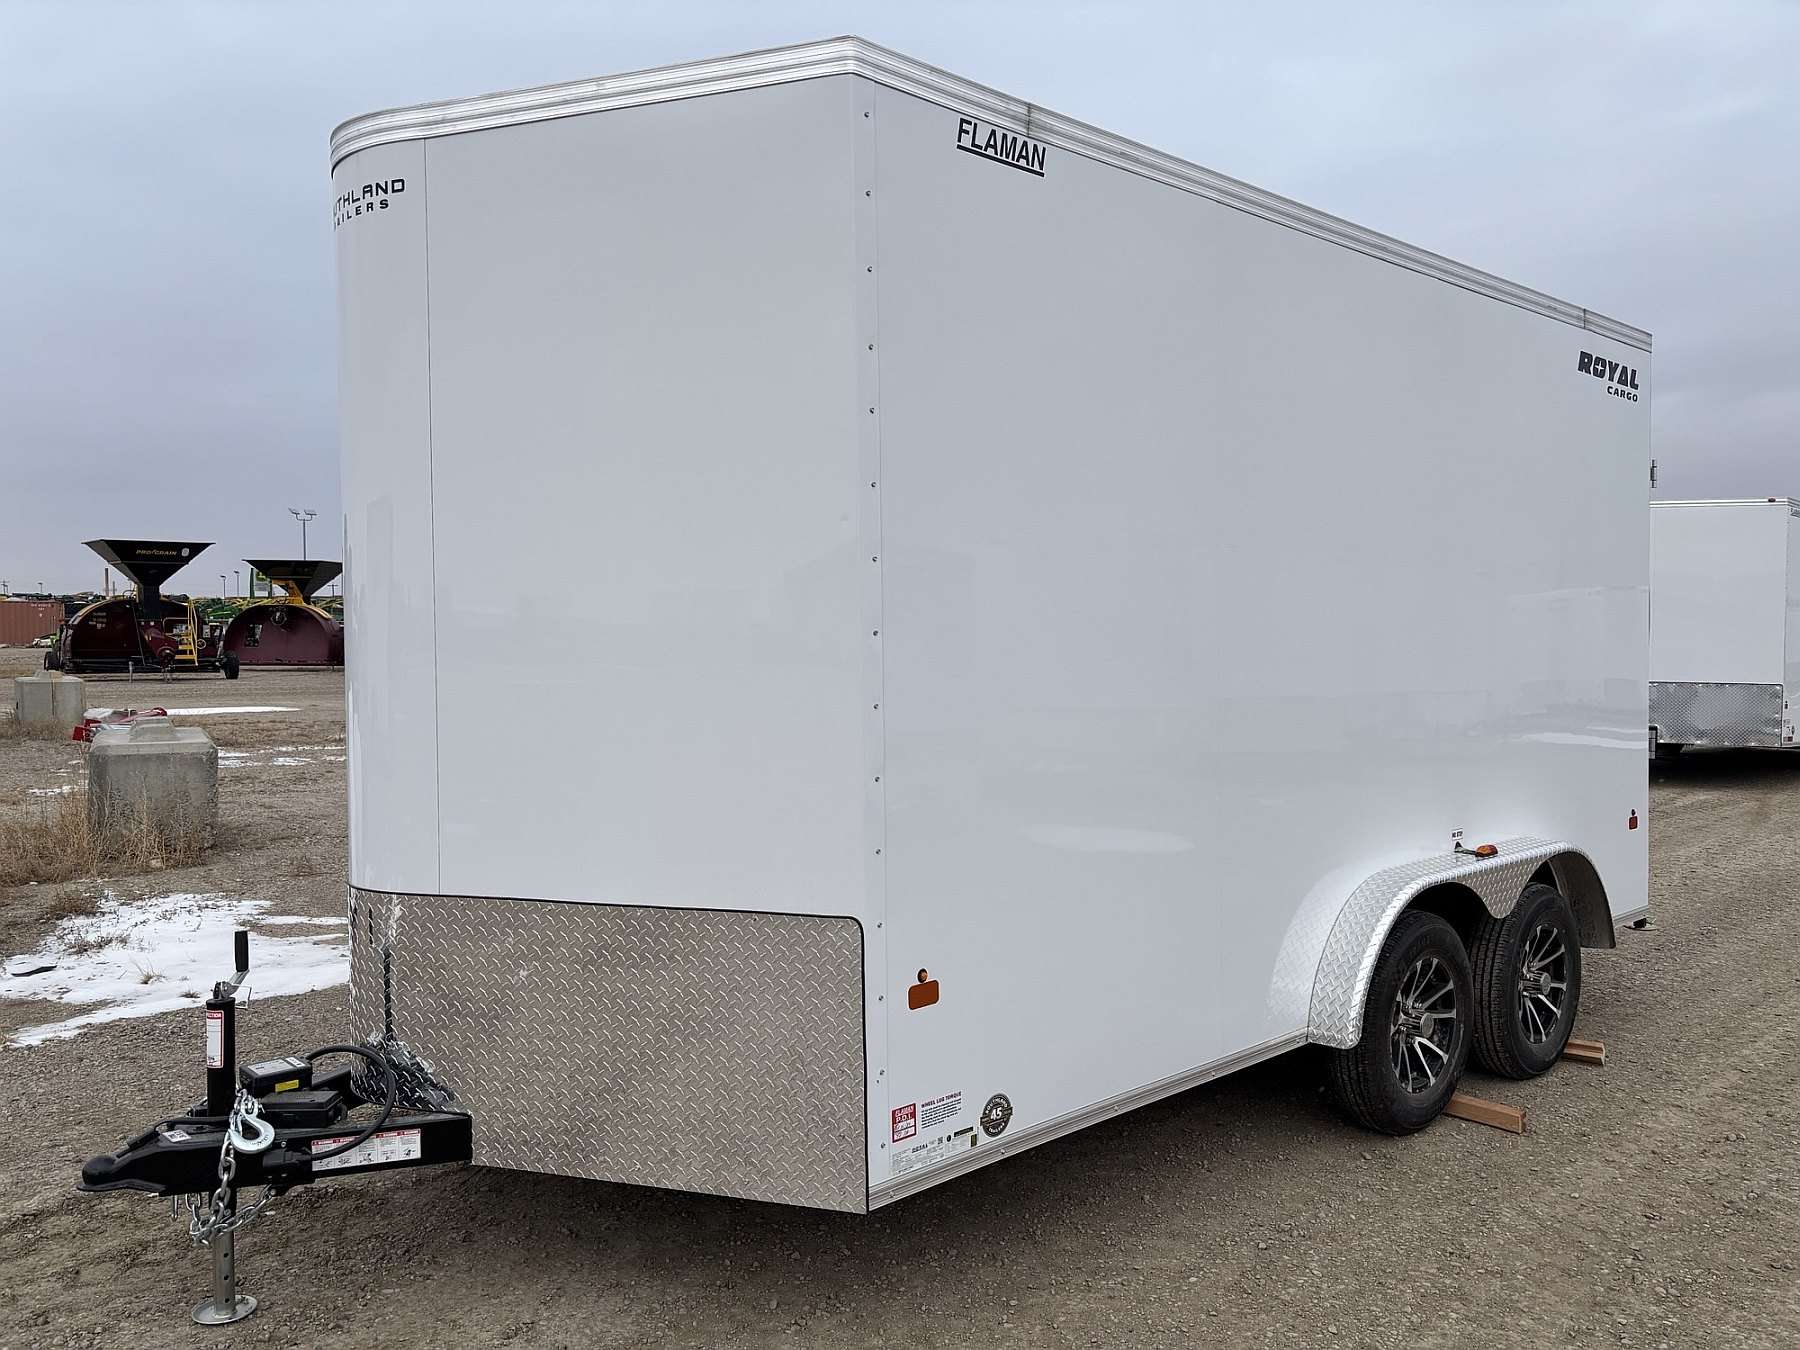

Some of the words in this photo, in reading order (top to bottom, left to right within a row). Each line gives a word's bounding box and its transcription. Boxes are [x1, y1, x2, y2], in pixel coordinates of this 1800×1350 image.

[957, 117, 1046, 171] FLAMAN
[1577, 350, 1640, 391] ROYAL
[1606, 385, 1638, 402] CARGO
[990, 1107, 1003, 1120] 45
